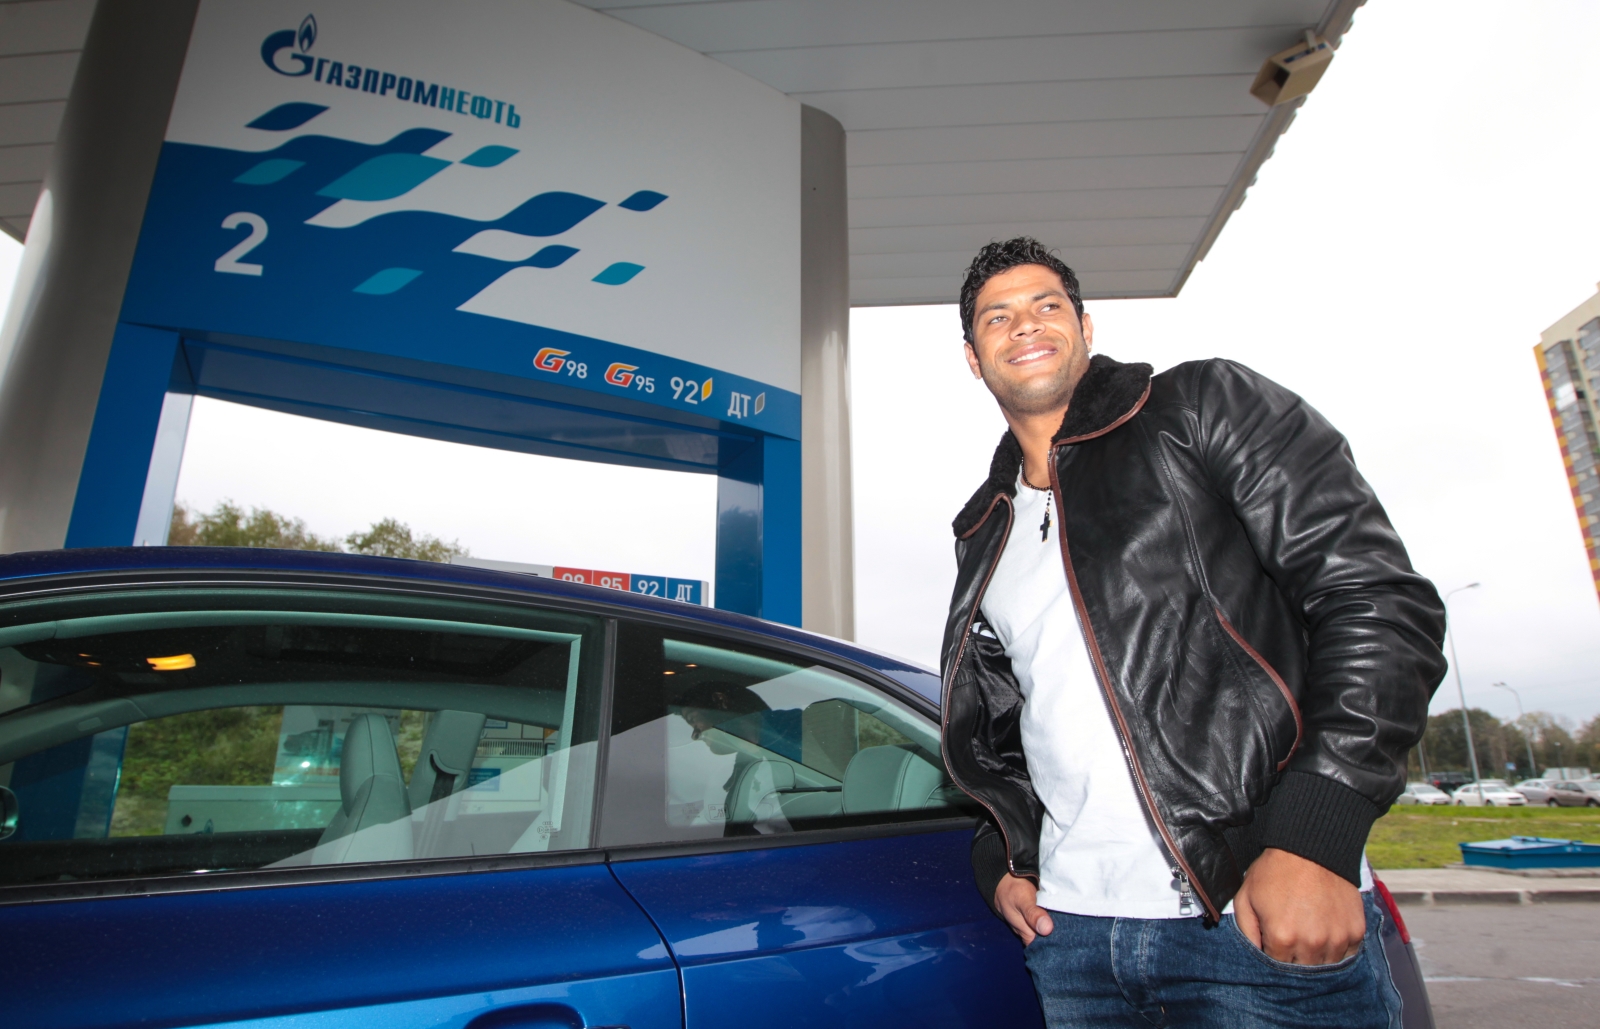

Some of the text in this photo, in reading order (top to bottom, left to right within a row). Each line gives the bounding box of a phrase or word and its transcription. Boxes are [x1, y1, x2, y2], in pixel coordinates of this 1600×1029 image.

[314, 57, 521, 129] ГАЗПРОМНЕФТЬ
[214, 211, 269, 276] 2
[670, 376, 699, 404] 92
[727, 391, 751, 419] ДТ
[638, 580, 659, 597] 92
[675, 584, 693, 602] ДТ
